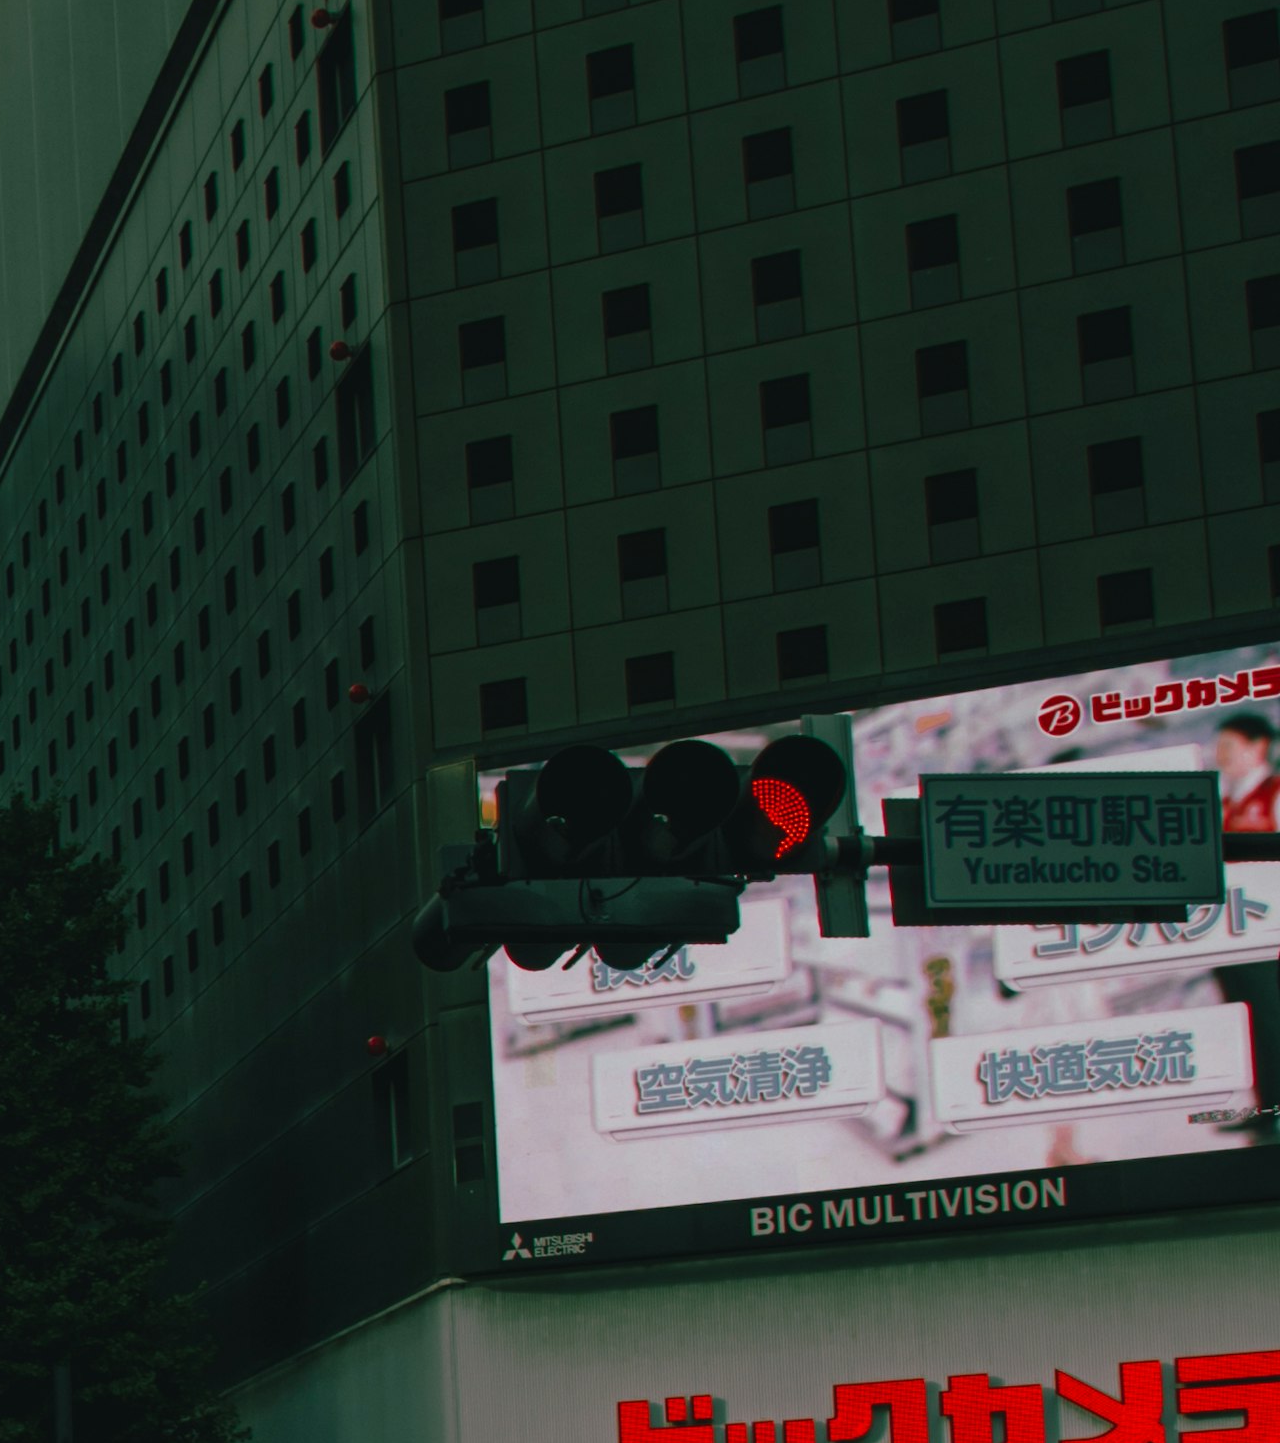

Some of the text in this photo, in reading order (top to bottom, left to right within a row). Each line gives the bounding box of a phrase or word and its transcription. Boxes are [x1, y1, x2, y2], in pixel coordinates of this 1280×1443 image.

[1091, 667, 1280, 723] ビックカメラ
[935, 794, 1209, 849] 有楽町駅前
[964, 855, 1186, 885] Yurakucho Sta.
[638, 1046, 832, 1113] 空気清浄
[980, 1031, 1196, 1104] 快適気流
[751, 1176, 1067, 1236] BIC MULTIVISION
[534, 1233, 593, 1247] MITSUBISHI
[535, 1244, 586, 1258] ELECTRIC
